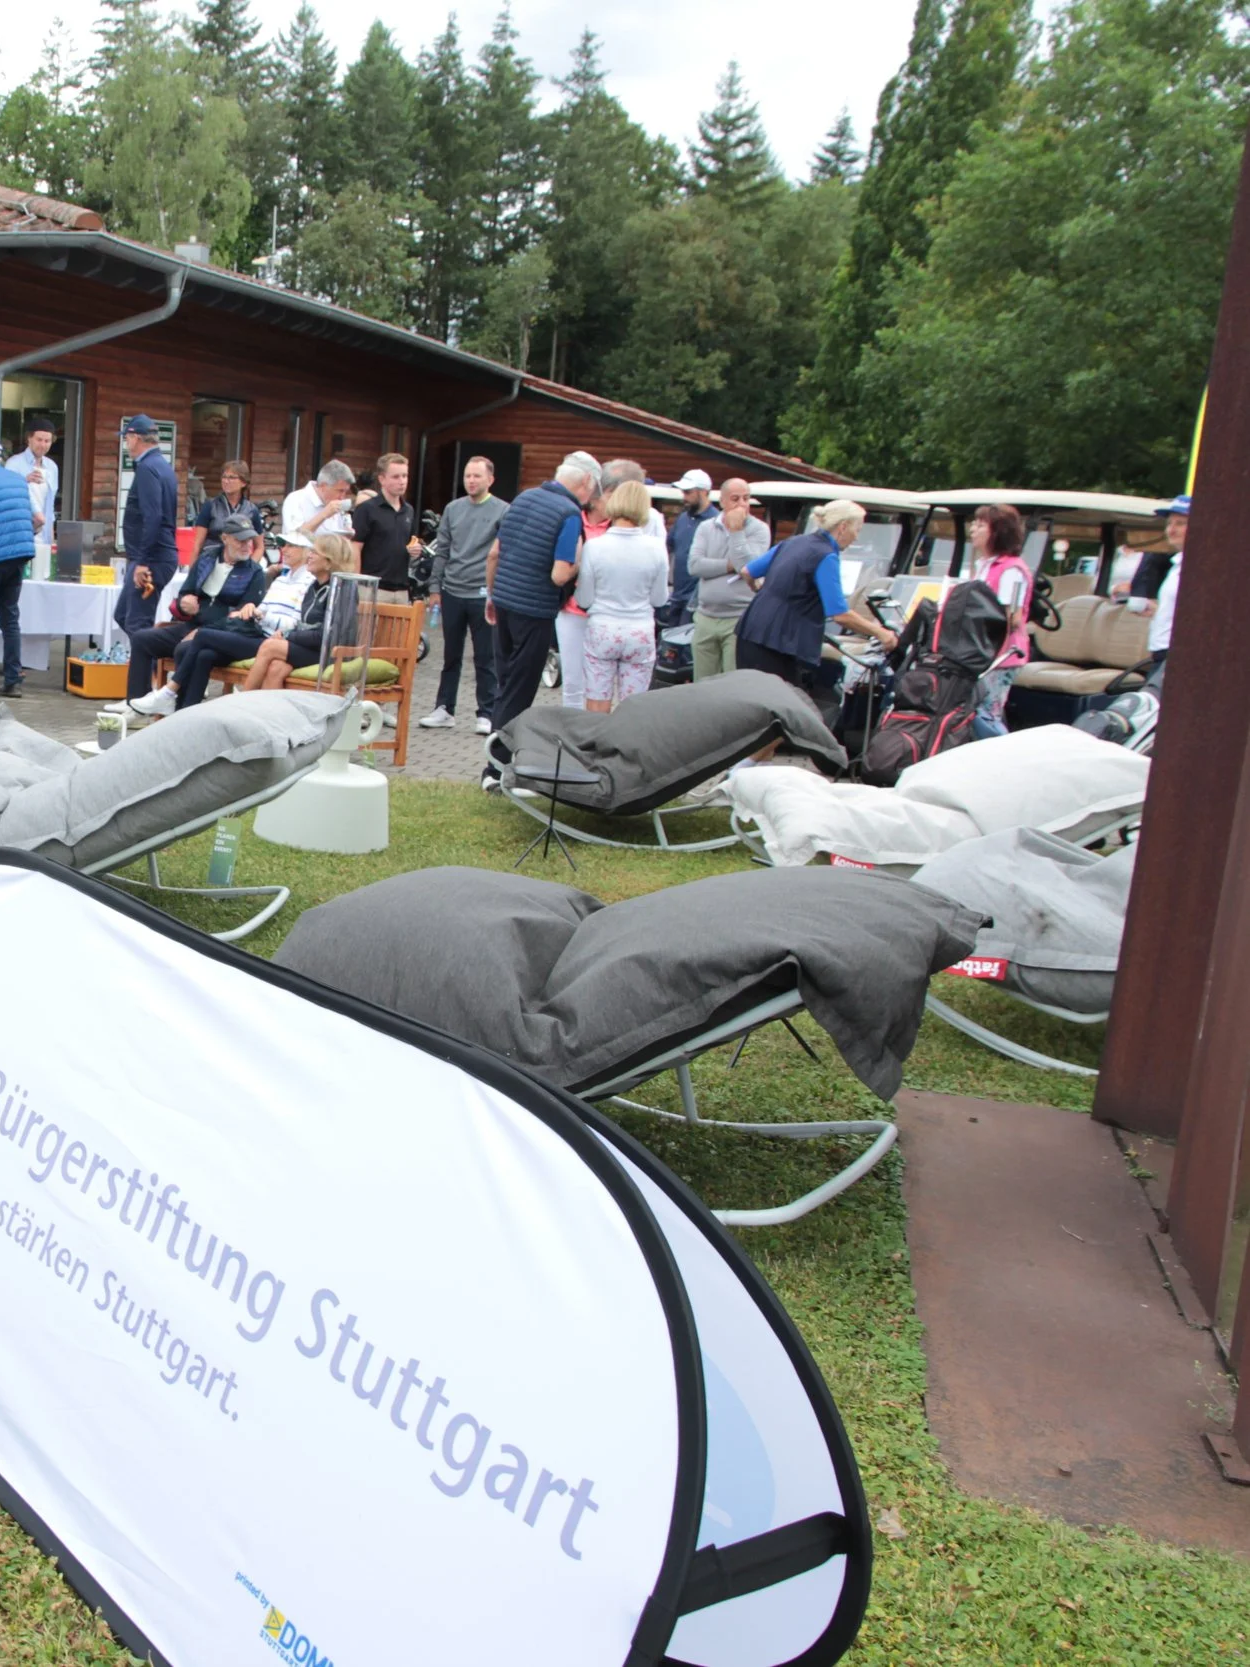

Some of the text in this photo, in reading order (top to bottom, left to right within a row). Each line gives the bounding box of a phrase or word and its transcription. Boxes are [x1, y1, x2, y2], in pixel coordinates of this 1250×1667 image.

[951, 959, 1001, 977] fatbo
[94, 1270, 239, 1422] Stuttgart.
[294, 1288, 599, 1561] Stuttgart
[235, 1571, 271, 1609] printed by
[279, 1619, 334, 1667] DOM
